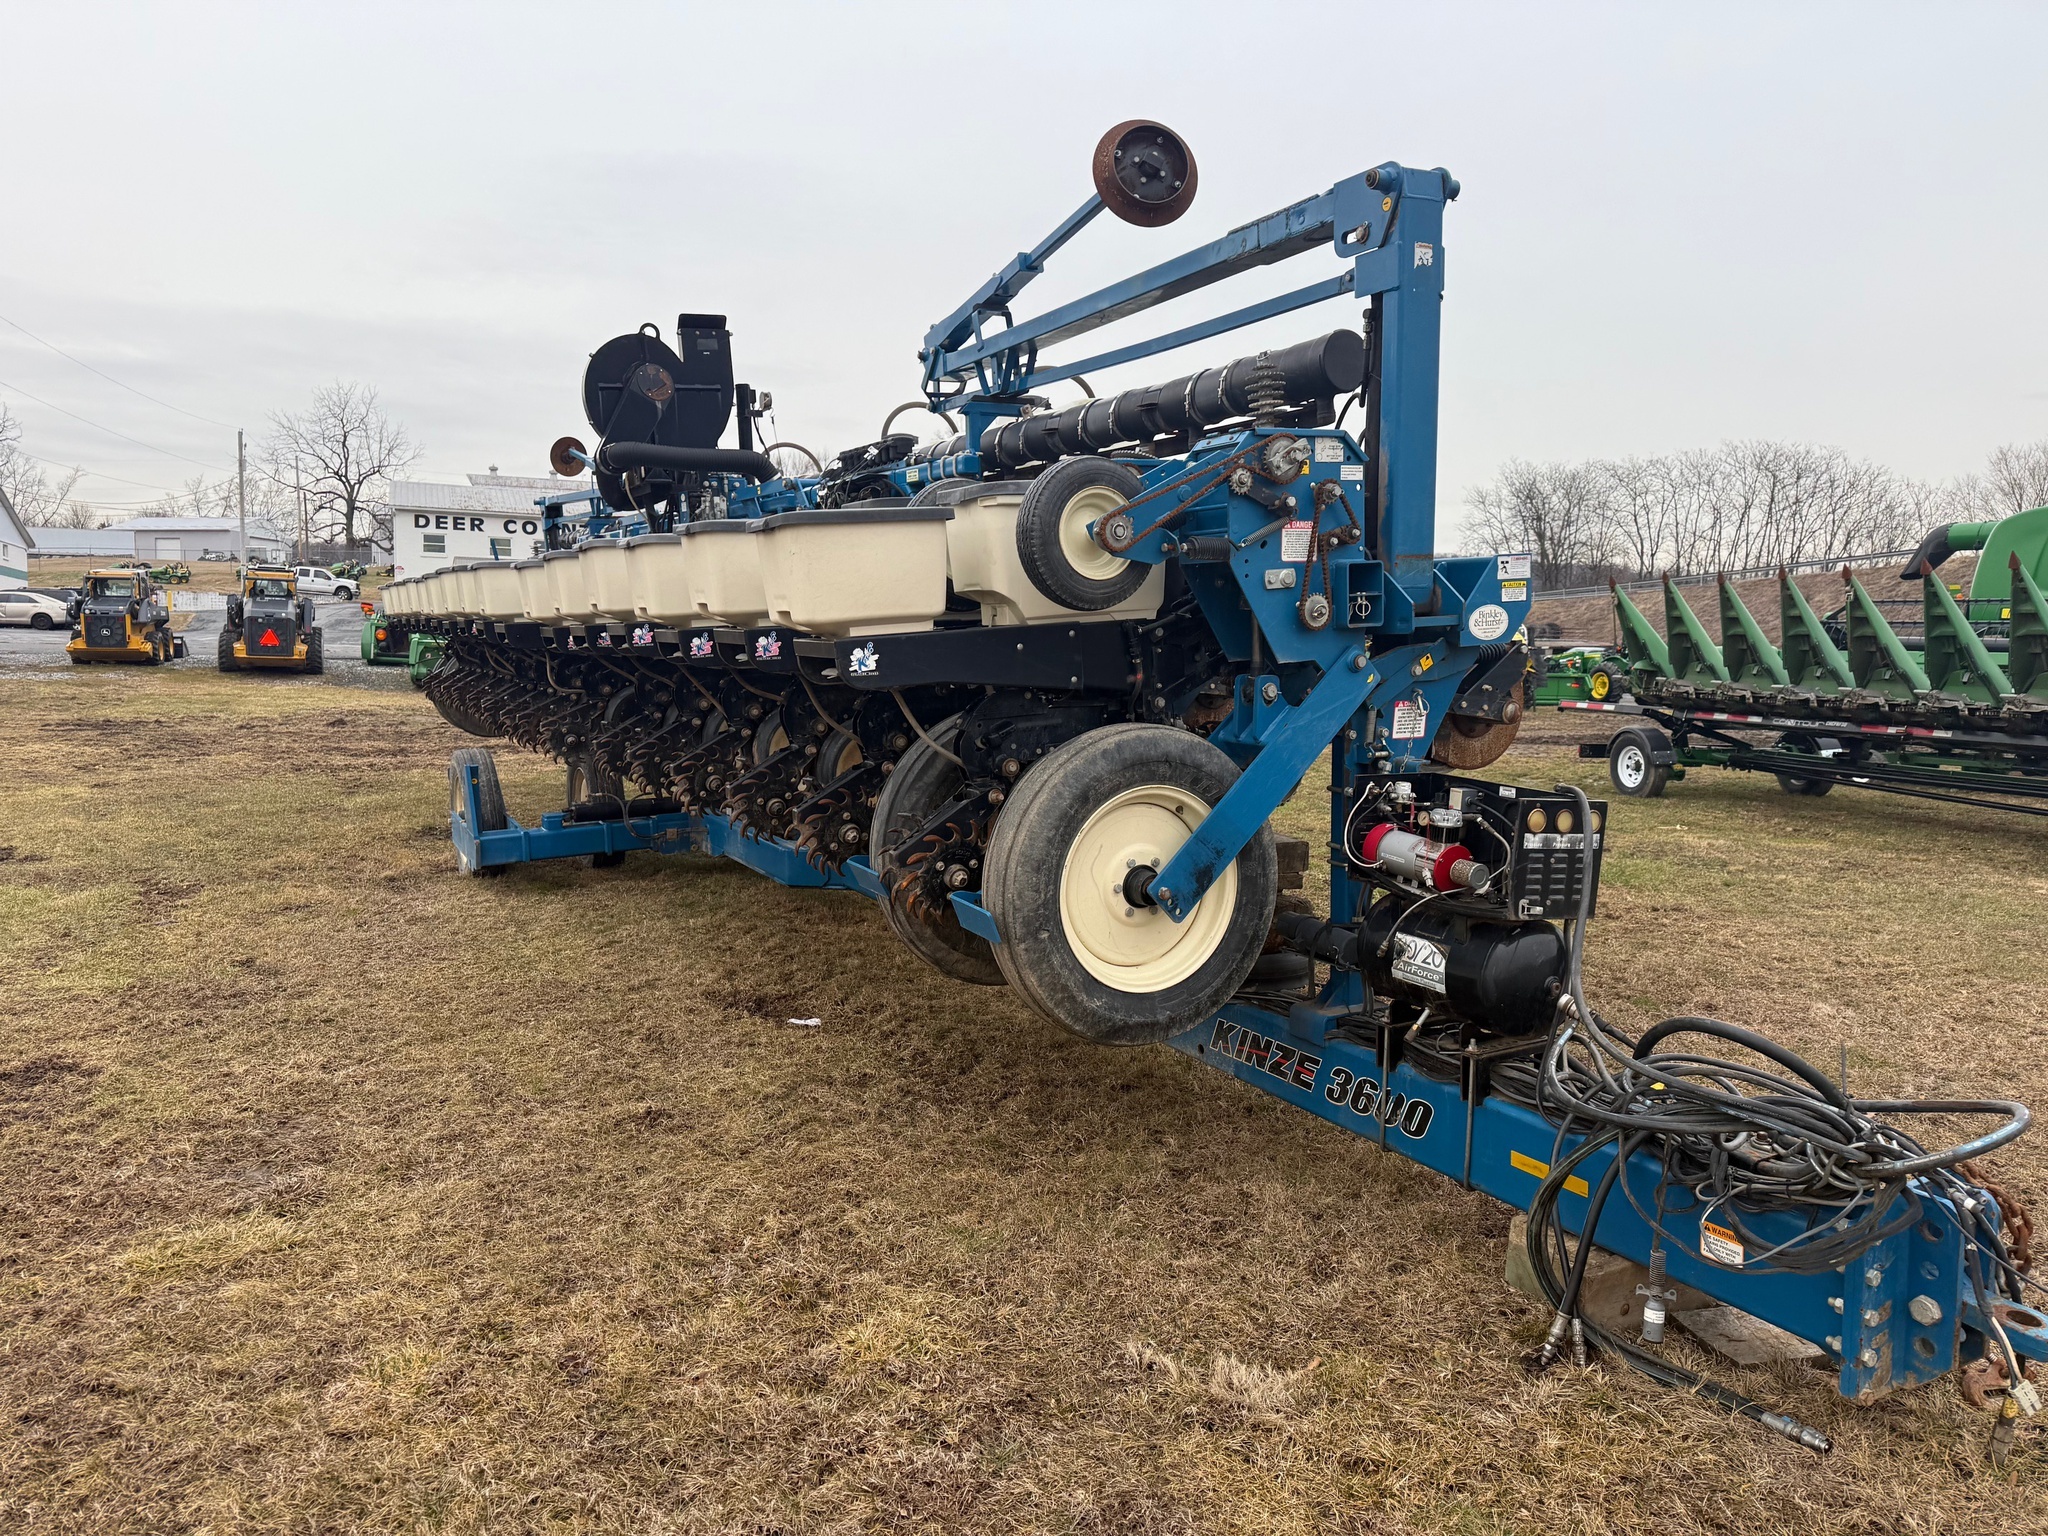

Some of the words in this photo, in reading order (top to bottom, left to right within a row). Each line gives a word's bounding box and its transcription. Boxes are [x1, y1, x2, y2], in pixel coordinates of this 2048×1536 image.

[414, 513, 485, 533] DEER
[1292, 521, 1313, 529] DANGE
[1478, 609, 1504, 620] Binkley
[1397, 961, 1440, 981] AirForce
[1209, 1017, 1323, 1093] KINZE
[1324, 1066, 1435, 1140] 3600
[1712, 1226, 1737, 1242] WARNIN
